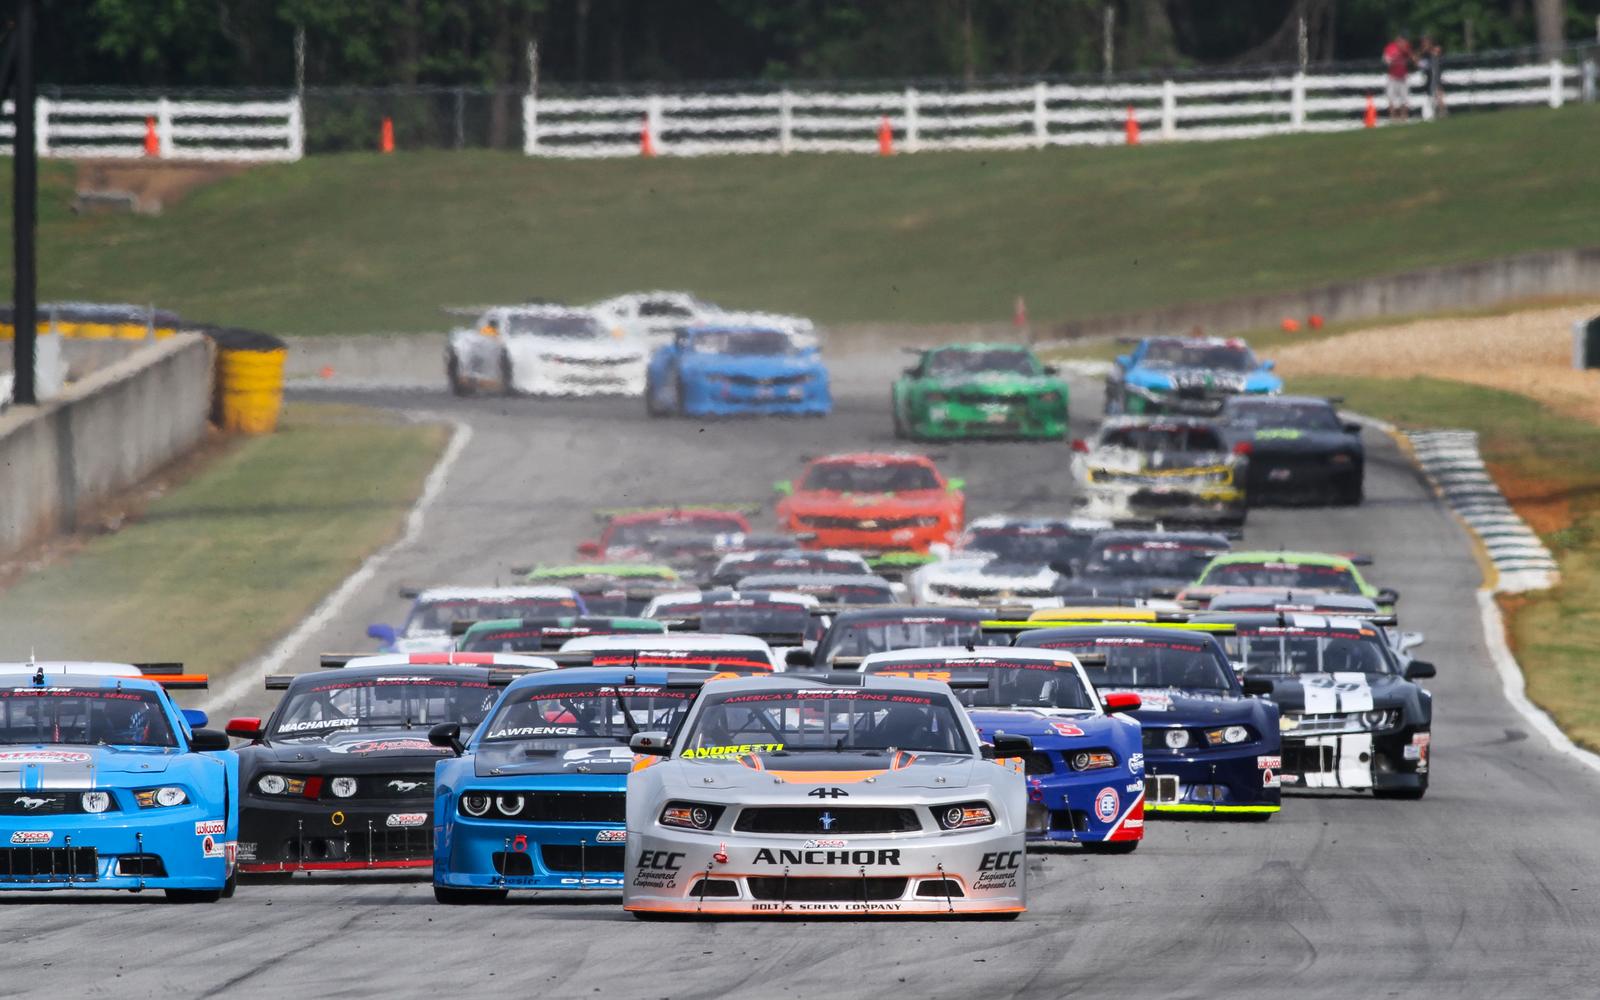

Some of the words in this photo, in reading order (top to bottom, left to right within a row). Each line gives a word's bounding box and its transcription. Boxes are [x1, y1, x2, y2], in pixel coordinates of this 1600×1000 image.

[1024, 663, 1059, 671] SERIES
[51, 690, 101, 698] RACING
[103, 692, 145, 701] SERIES
[530, 690, 594, 701] AMERICA'S
[635, 691, 685, 699] RACING
[723, 692, 793, 704] AMERICA'S
[796, 691, 833, 699] ROAD
[836, 692, 888, 701] RACING
[892, 694, 932, 705] SERIES
[278, 718, 359, 734] MACHAVERN
[487, 727, 579, 739] LAWRENCE
[679, 743, 785, 758] ANDRETTI
[636, 849, 687, 870] ECC
[752, 848, 901, 865] ANCHOR
[978, 850, 1023, 872] ECC
[637, 869, 677, 881] Engineered
[978, 870, 1016, 883] Engineered
[632, 879, 664, 889] Components
[972, 880, 1008, 891] Components
